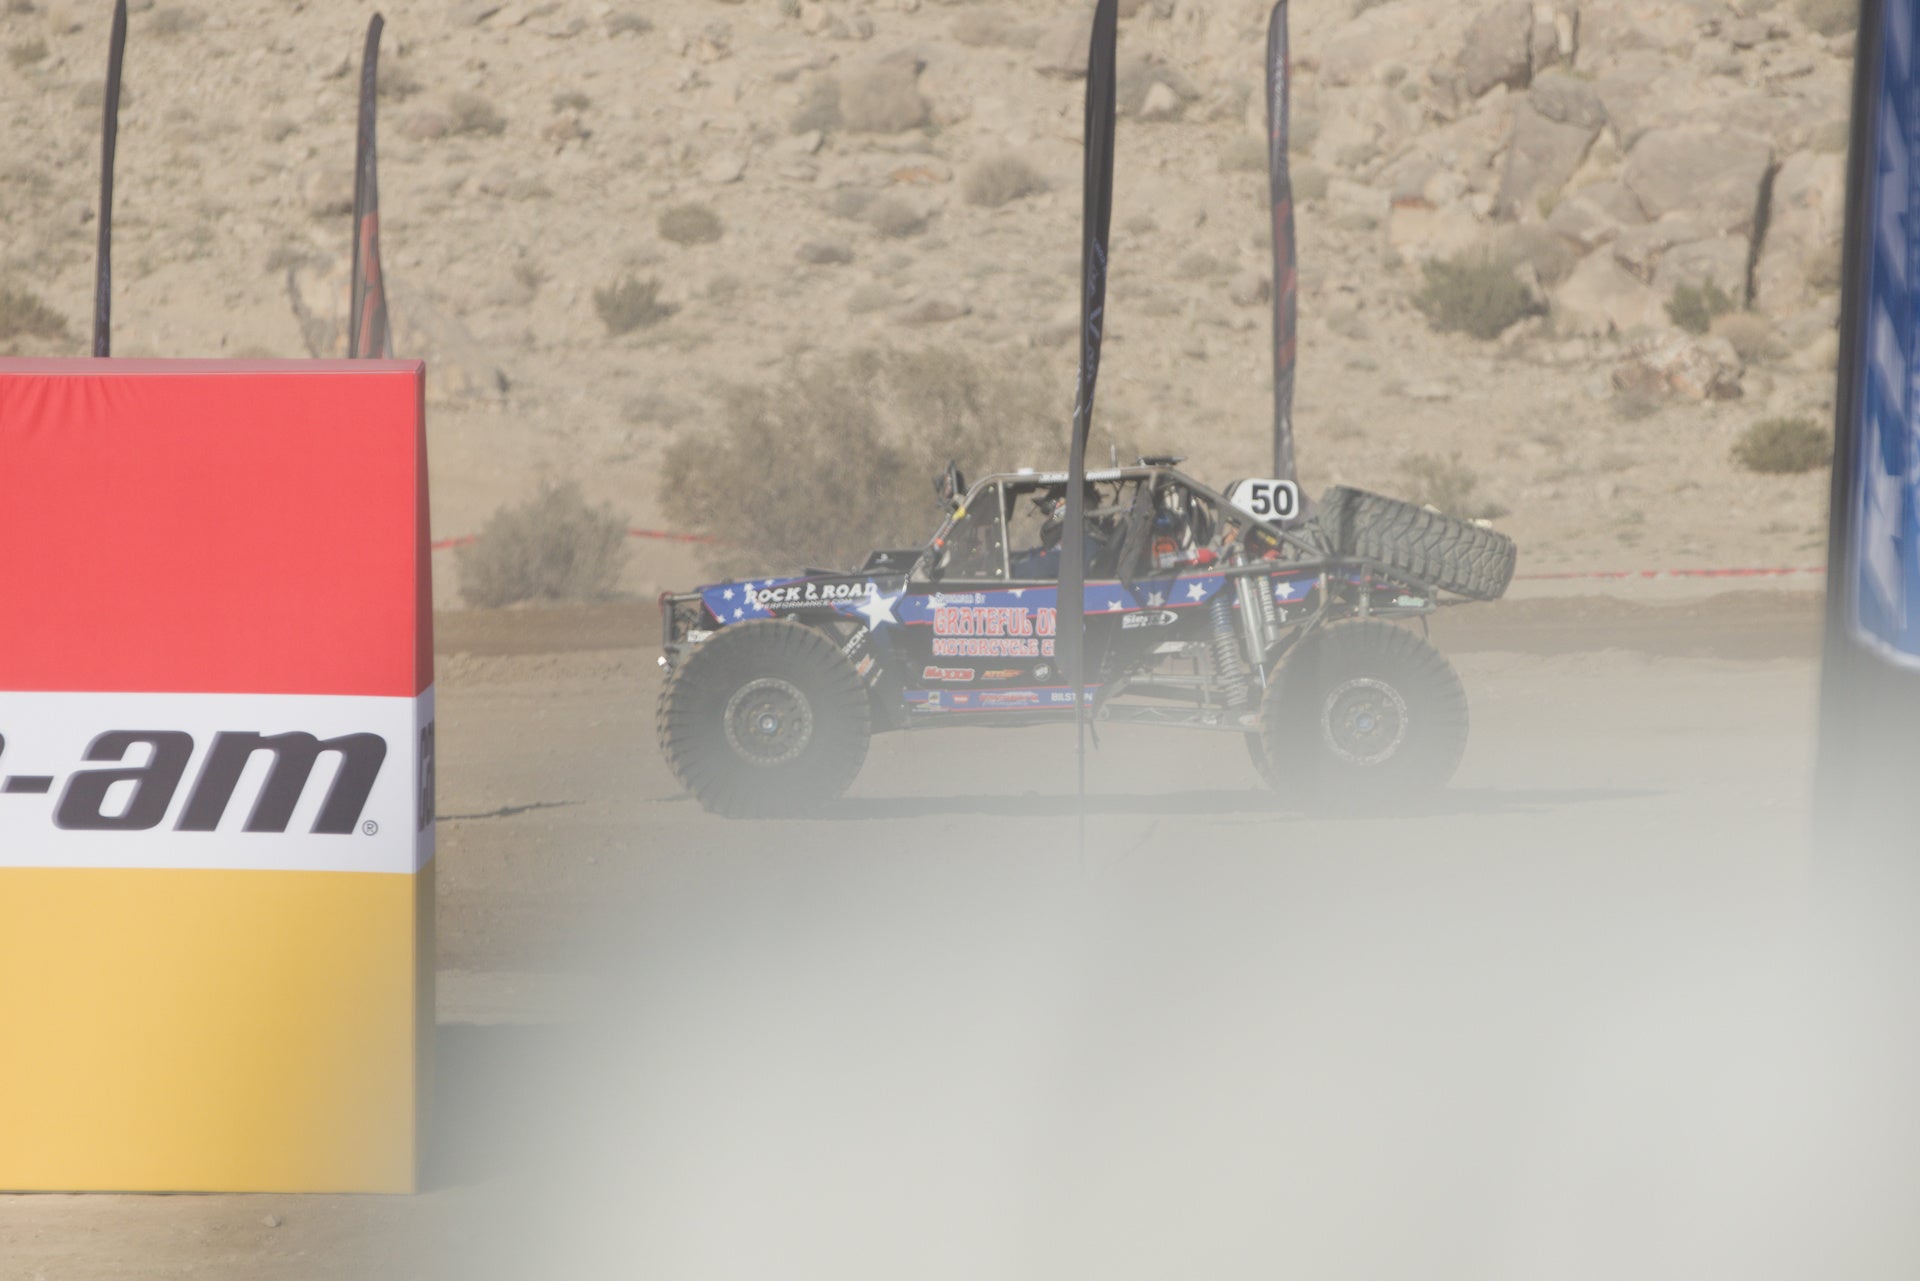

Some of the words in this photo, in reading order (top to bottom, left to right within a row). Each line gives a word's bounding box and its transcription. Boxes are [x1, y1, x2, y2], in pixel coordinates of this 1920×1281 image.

[1251, 483, 1294, 516] 50
[743, 586, 802, 605] ROCK
[821, 582, 878, 600] ROAD
[933, 606, 1034, 637] GRATEFUL
[932, 637, 1040, 657] MOTORCYCLE
[1041, 638, 1056, 657] C
[0, 729, 388, 835] -am
